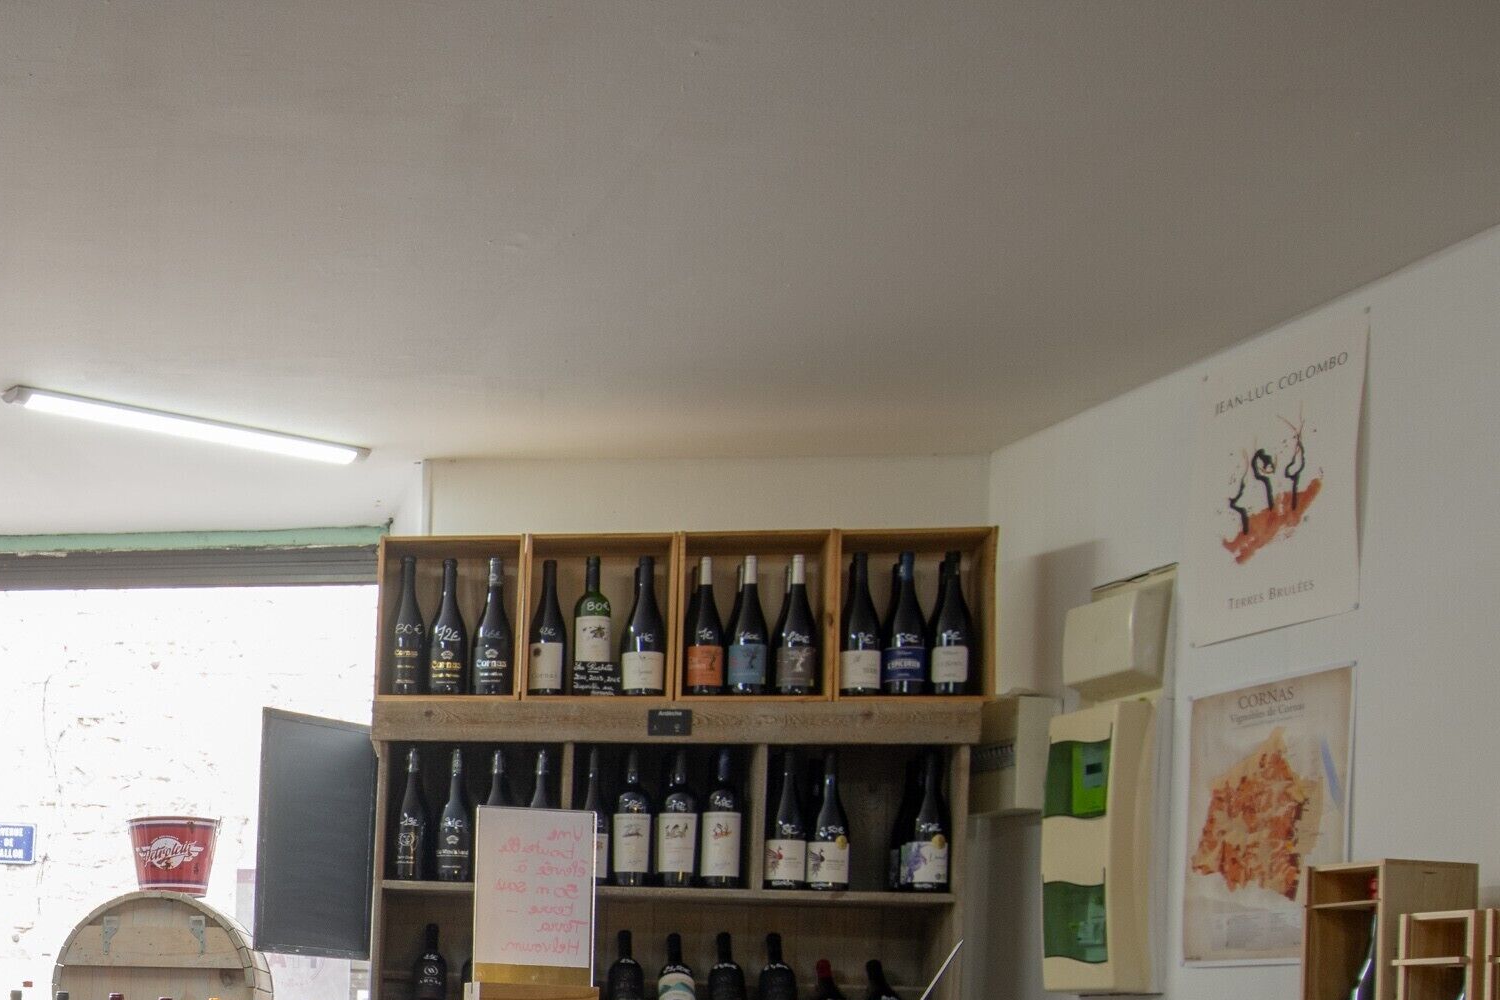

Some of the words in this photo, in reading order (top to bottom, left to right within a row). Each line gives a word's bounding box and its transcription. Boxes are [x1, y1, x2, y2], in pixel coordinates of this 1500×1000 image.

[1214, 381, 1275, 416] JEAN-LUC
[1278, 351, 1349, 391] COLOMBO
[1228, 592, 1264, 610] TERRES
[431, 660, 461, 670] Cornas
[476, 660, 507, 668] Cornas
[1238, 686, 1294, 710] CORNAS
